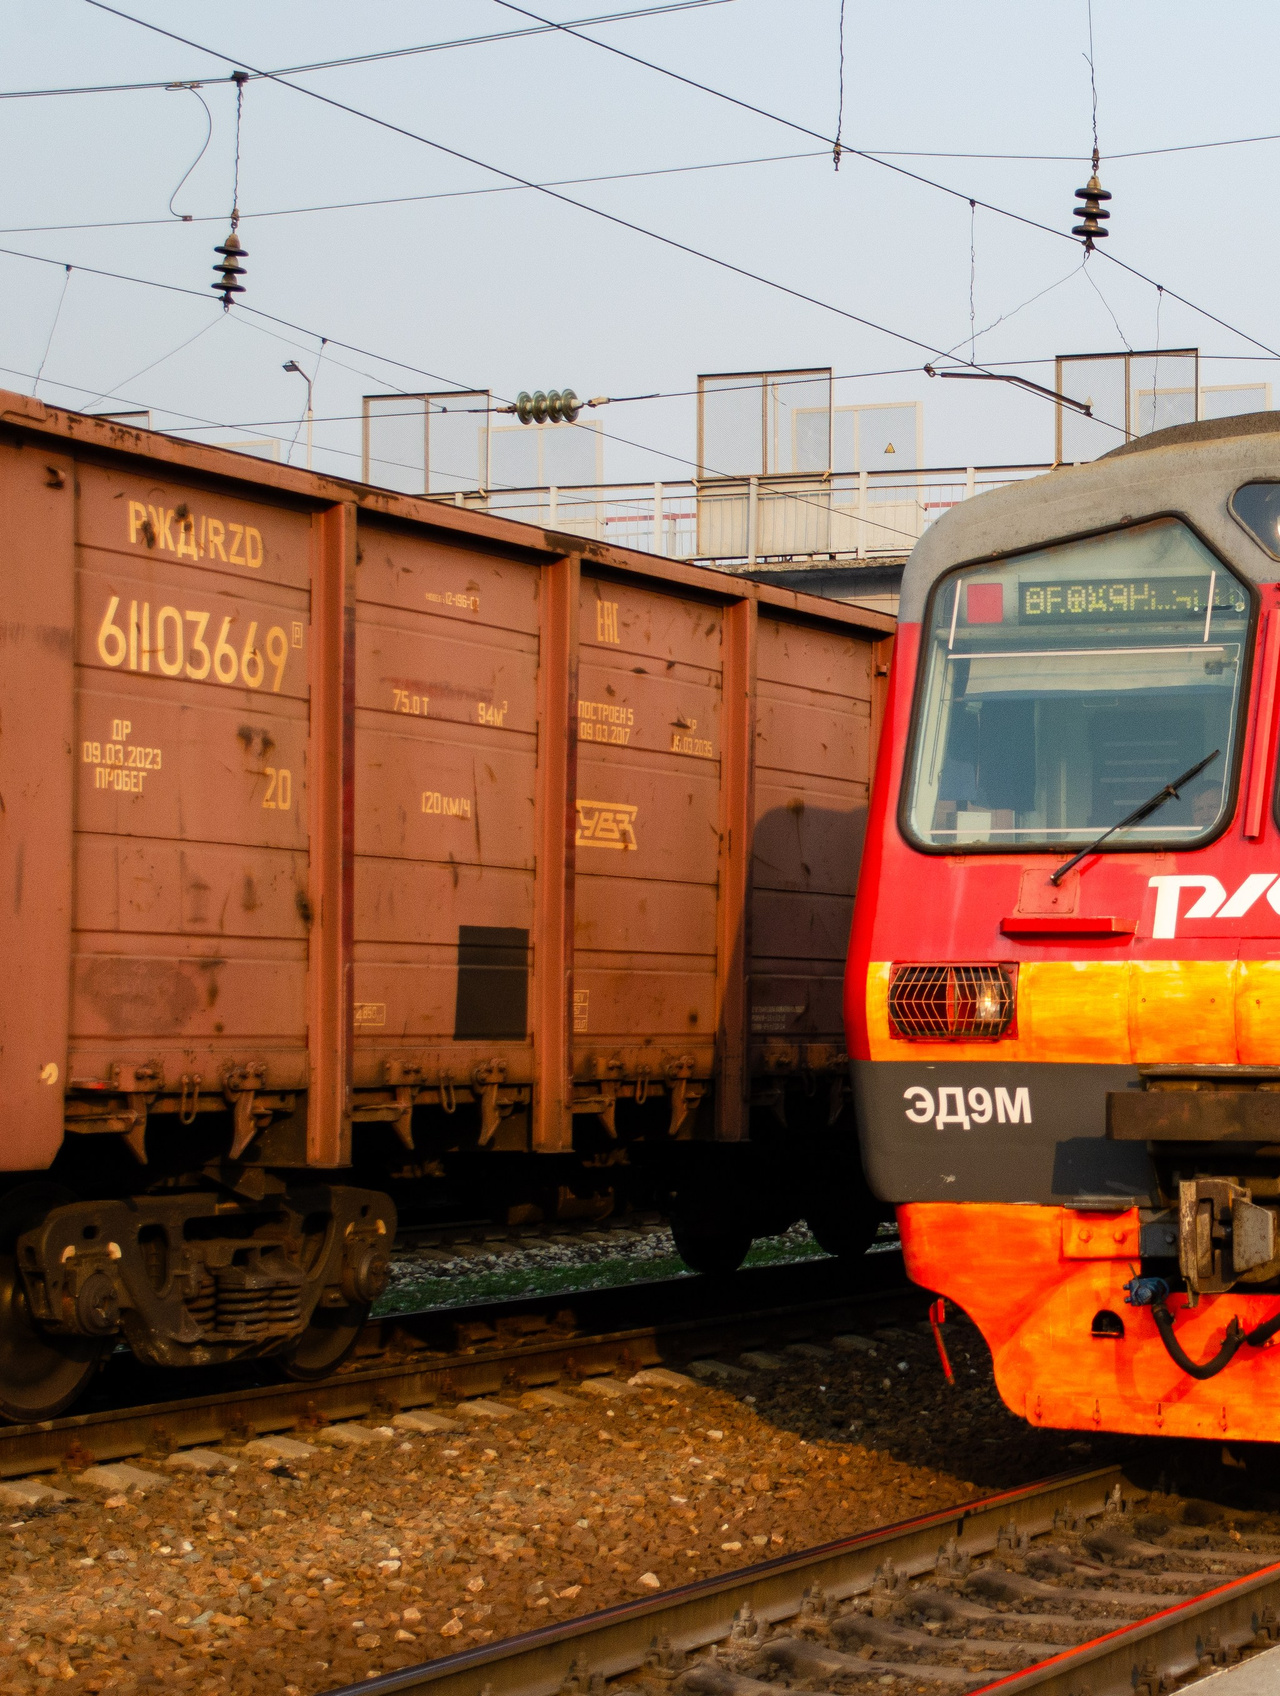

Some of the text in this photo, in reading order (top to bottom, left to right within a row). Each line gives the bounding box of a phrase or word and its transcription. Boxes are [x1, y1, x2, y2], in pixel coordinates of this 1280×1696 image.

[98, 596, 289, 692] 61103669
[578, 701, 626, 724] ПОСТРОЕН
[580, 722, 631, 744] 09.03.2017
[83, 741, 162, 770] 09.03.2023
[95, 767, 148, 792] ПРОБЕГ
[262, 767, 292, 810] 20
[903, 1086, 1032, 1130] ЭД9М
